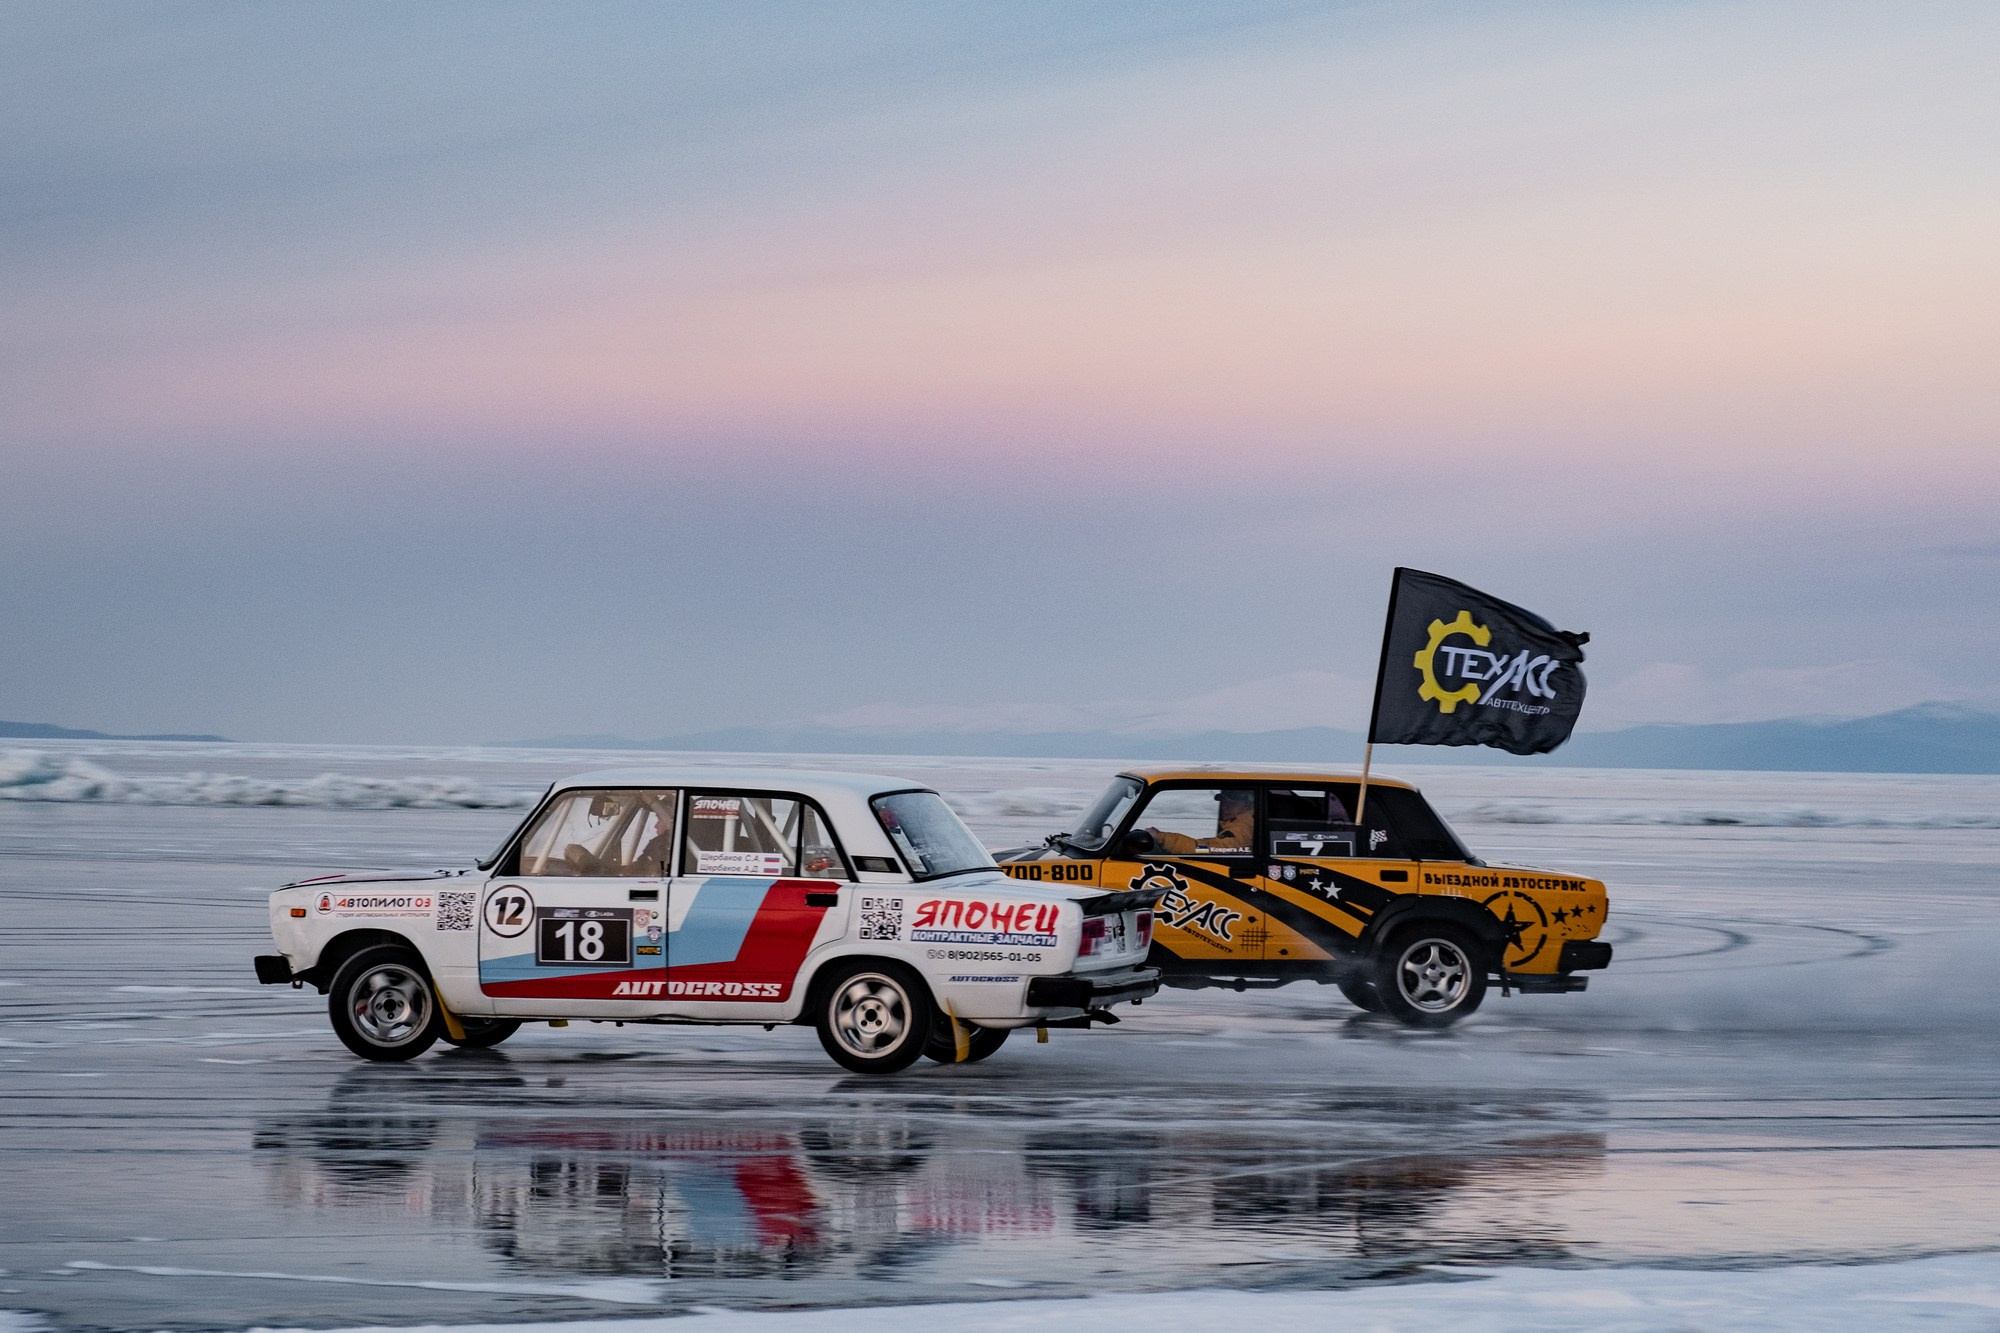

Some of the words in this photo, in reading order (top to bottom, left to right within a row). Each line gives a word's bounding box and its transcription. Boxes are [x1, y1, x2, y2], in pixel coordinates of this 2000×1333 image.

[693, 799, 741, 811] ЯПОНЕЦ
[701, 853, 743, 863] Щербаков
[700, 863, 742, 873] Щербаков
[1424, 873, 1499, 887] ВЫЕЗДНОЙ
[1503, 877, 1587, 892] АВТОСЕРВИС
[337, 897, 412, 908] АВТОПИЛОТ
[495, 896, 526, 926] 12
[911, 900, 1060, 936] ЯПОНЕЦ
[1149, 880, 1241, 941] ЕХАСС
[555, 921, 605, 961] 18
[912, 931, 994, 943] КОНТРАКТНЫЕ
[996, 934, 1056, 946] ЗАПЧАСТИ
[947, 951, 1042, 962] 8(902)565-01-05
[612, 981, 783, 997] AUTOCROSS
